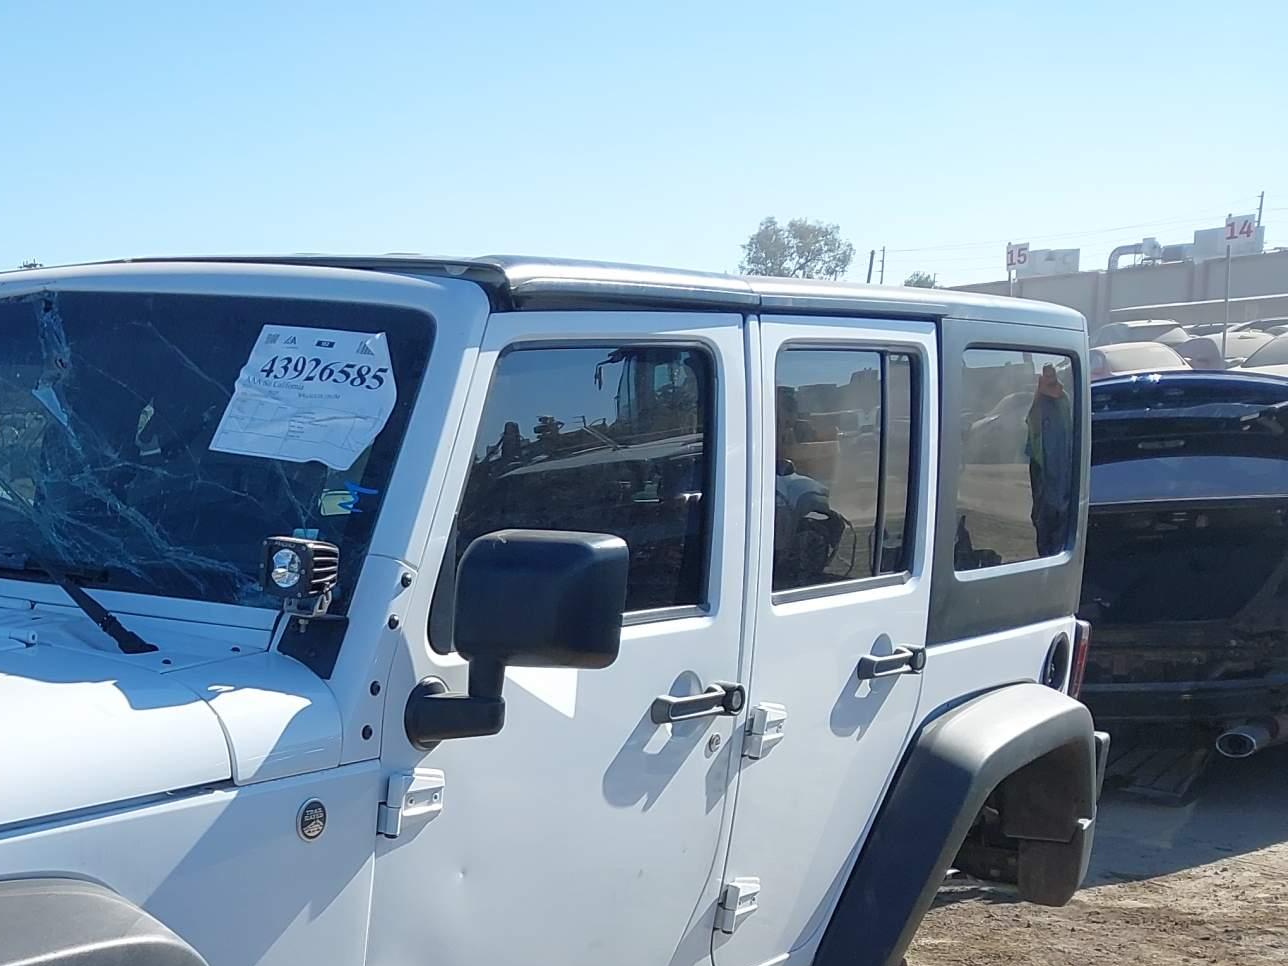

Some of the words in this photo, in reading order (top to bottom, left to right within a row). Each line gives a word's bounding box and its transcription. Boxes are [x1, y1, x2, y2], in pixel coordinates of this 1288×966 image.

[1225, 219, 1253, 240] 14
[1007, 247, 1028, 266] 15
[260, 355, 389, 390] 43926585
